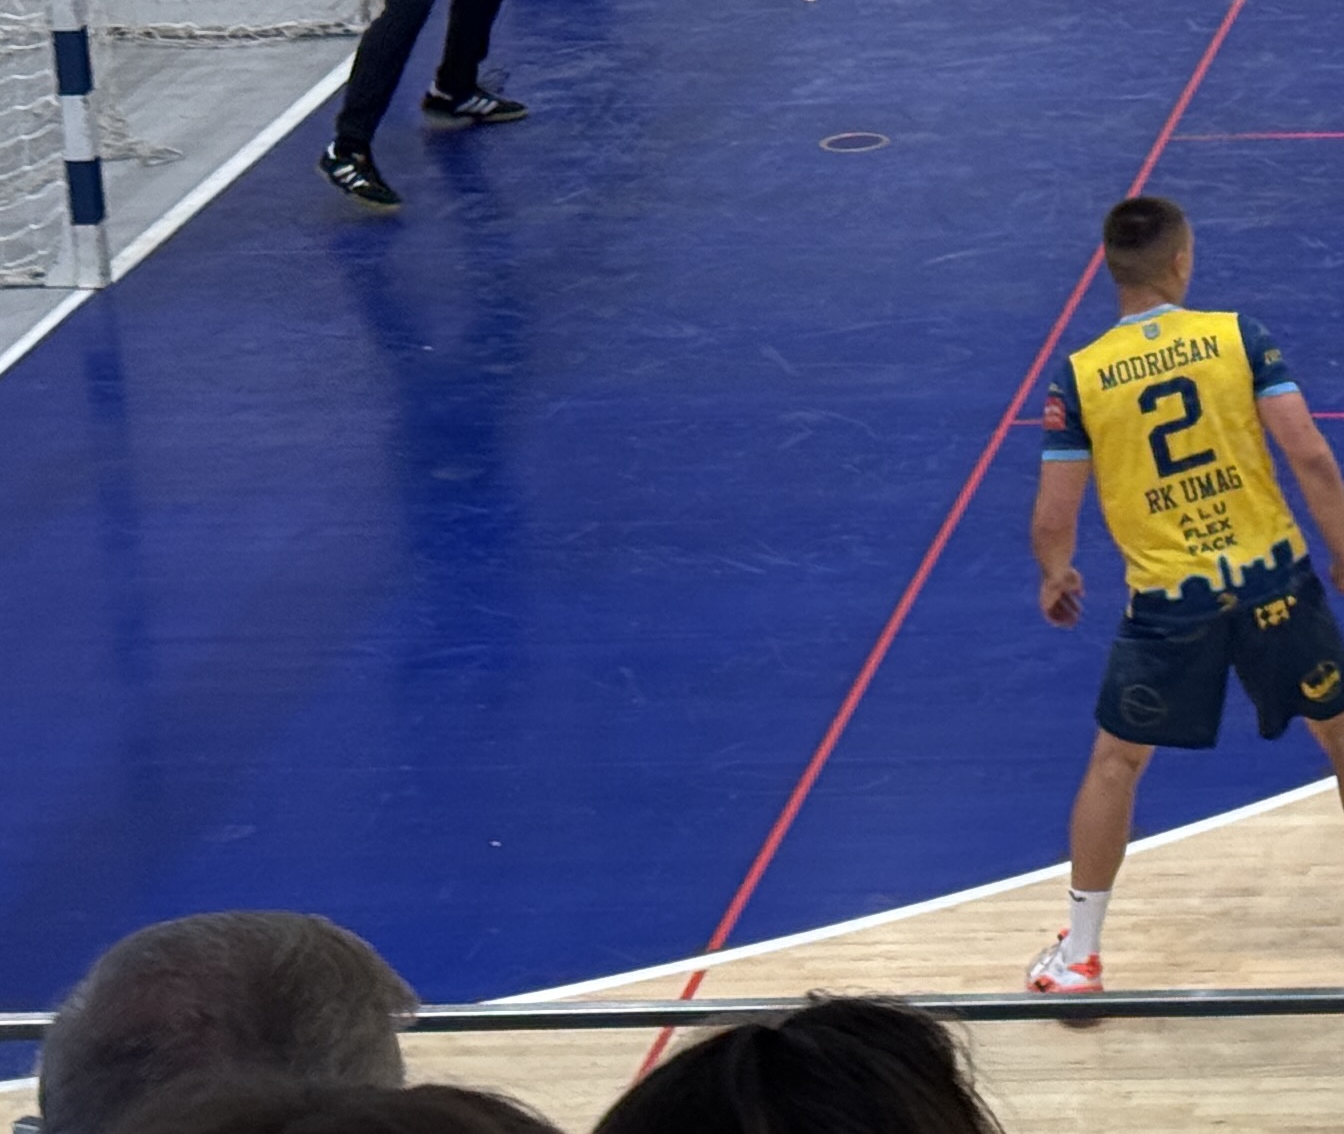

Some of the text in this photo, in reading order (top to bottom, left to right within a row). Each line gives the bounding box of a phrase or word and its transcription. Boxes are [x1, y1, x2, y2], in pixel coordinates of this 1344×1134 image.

[1097, 336, 1221, 392] MODRUŠAN
[1136, 375, 1218, 480] 2
[1144, 465, 1244, 515] RK UMAG
[1183, 517, 1233, 542] FLEX
[1188, 533, 1238, 557] PACK
